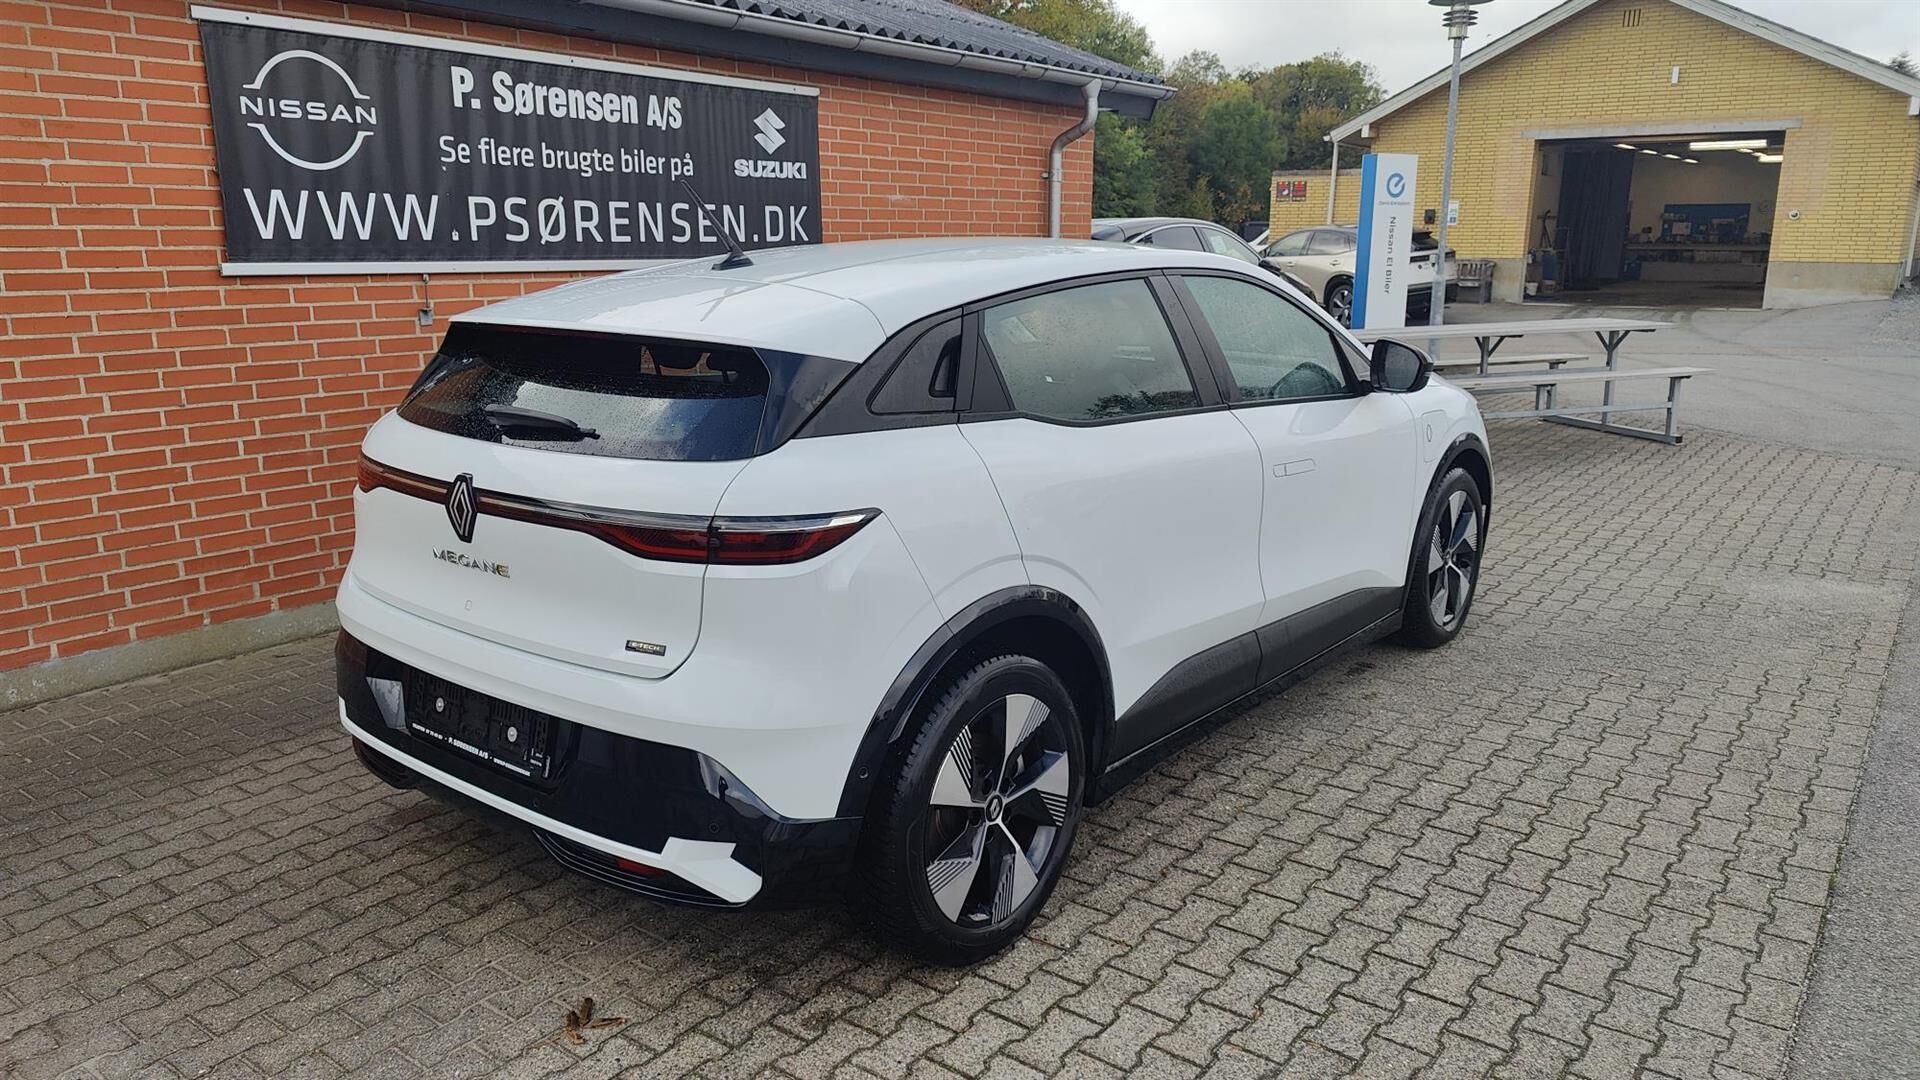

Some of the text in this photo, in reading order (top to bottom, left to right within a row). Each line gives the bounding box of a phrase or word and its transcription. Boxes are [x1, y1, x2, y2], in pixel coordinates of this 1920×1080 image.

[239, 95, 377, 125] NISSAN
[450, 65, 683, 131] P. Sørensen A/S
[438, 135, 694, 181] Se flere brugte biler på
[733, 158, 808, 179] SUZUKI
[242, 187, 809, 245] WWW.PSØRENSEN.DK
[1387, 216, 1397, 254] Nissan
[432, 546, 511, 578] MEGANE
